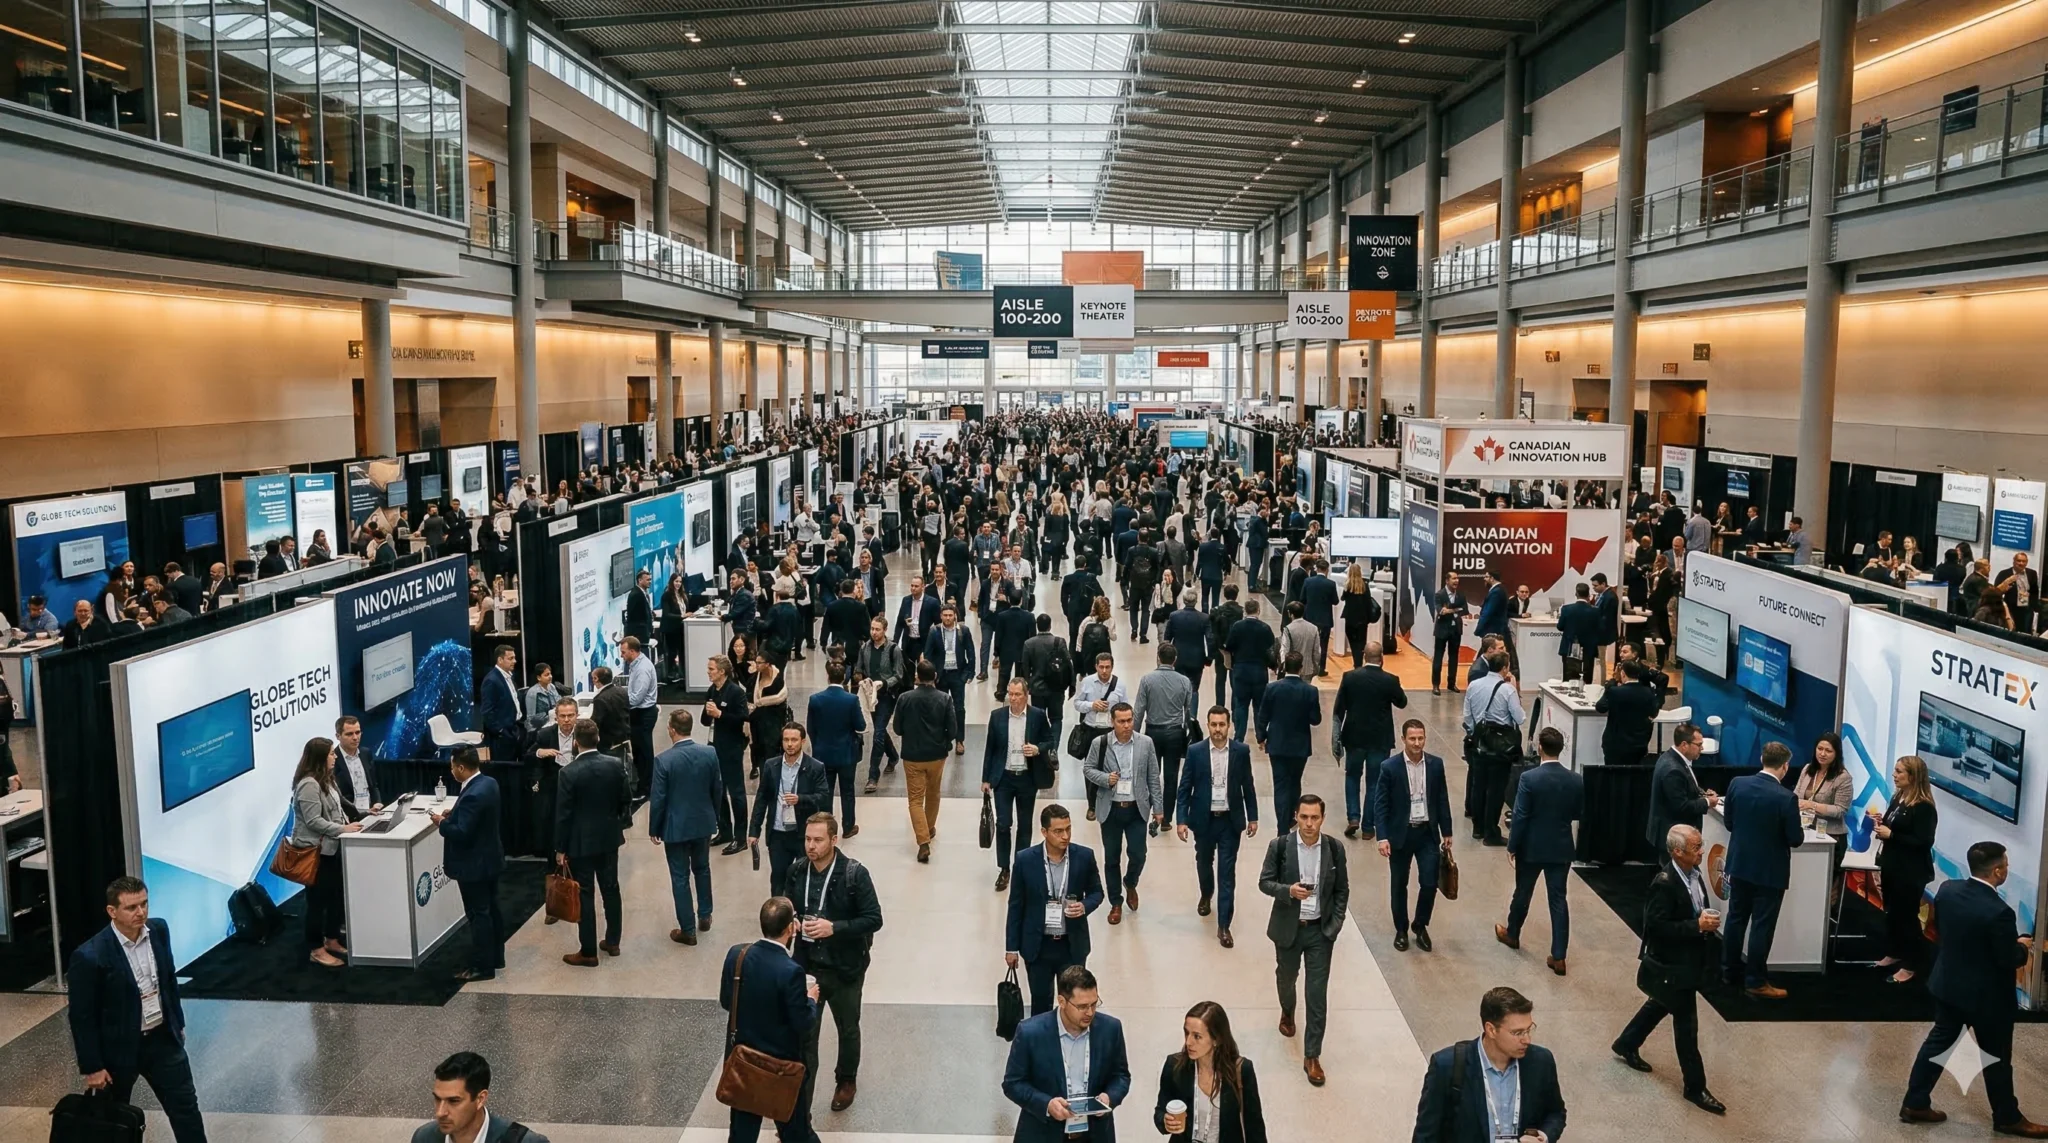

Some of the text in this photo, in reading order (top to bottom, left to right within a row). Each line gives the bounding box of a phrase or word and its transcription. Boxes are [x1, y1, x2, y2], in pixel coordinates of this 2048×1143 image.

[1356, 235, 1411, 246] INNOVATION
[1371, 247, 1396, 257] ZONE
[1001, 299, 1044, 311] AISLE
[1080, 302, 1127, 311] KEYNOTE
[1296, 304, 1331, 314] AISLE
[1000, 312, 1062, 325] 100-200
[1080, 312, 1125, 321] THEATER
[1296, 315, 1344, 326] 100-200
[1508, 441, 1571, 451] CANADIAN
[1508, 453, 1607, 463] INNOVATION HUB
[41, 511, 63, 522] GLOBE
[65, 509, 82, 518] TECH
[1453, 527, 1538, 540] CANADIAN
[1453, 542, 1553, 555] INNOVATION
[1452, 557, 1486, 570] HUB
[1699, 574, 1726, 592] STRATEX
[354, 578, 423, 620] INNOVATE
[426, 567, 457, 595] NOW
[1758, 595, 1827, 628] FUTURE CONNECT
[1931, 649, 2039, 711] STRATEX
[250, 664, 331, 710] GLOBE TECH
[253, 687, 327, 733] SOLUTIONS
